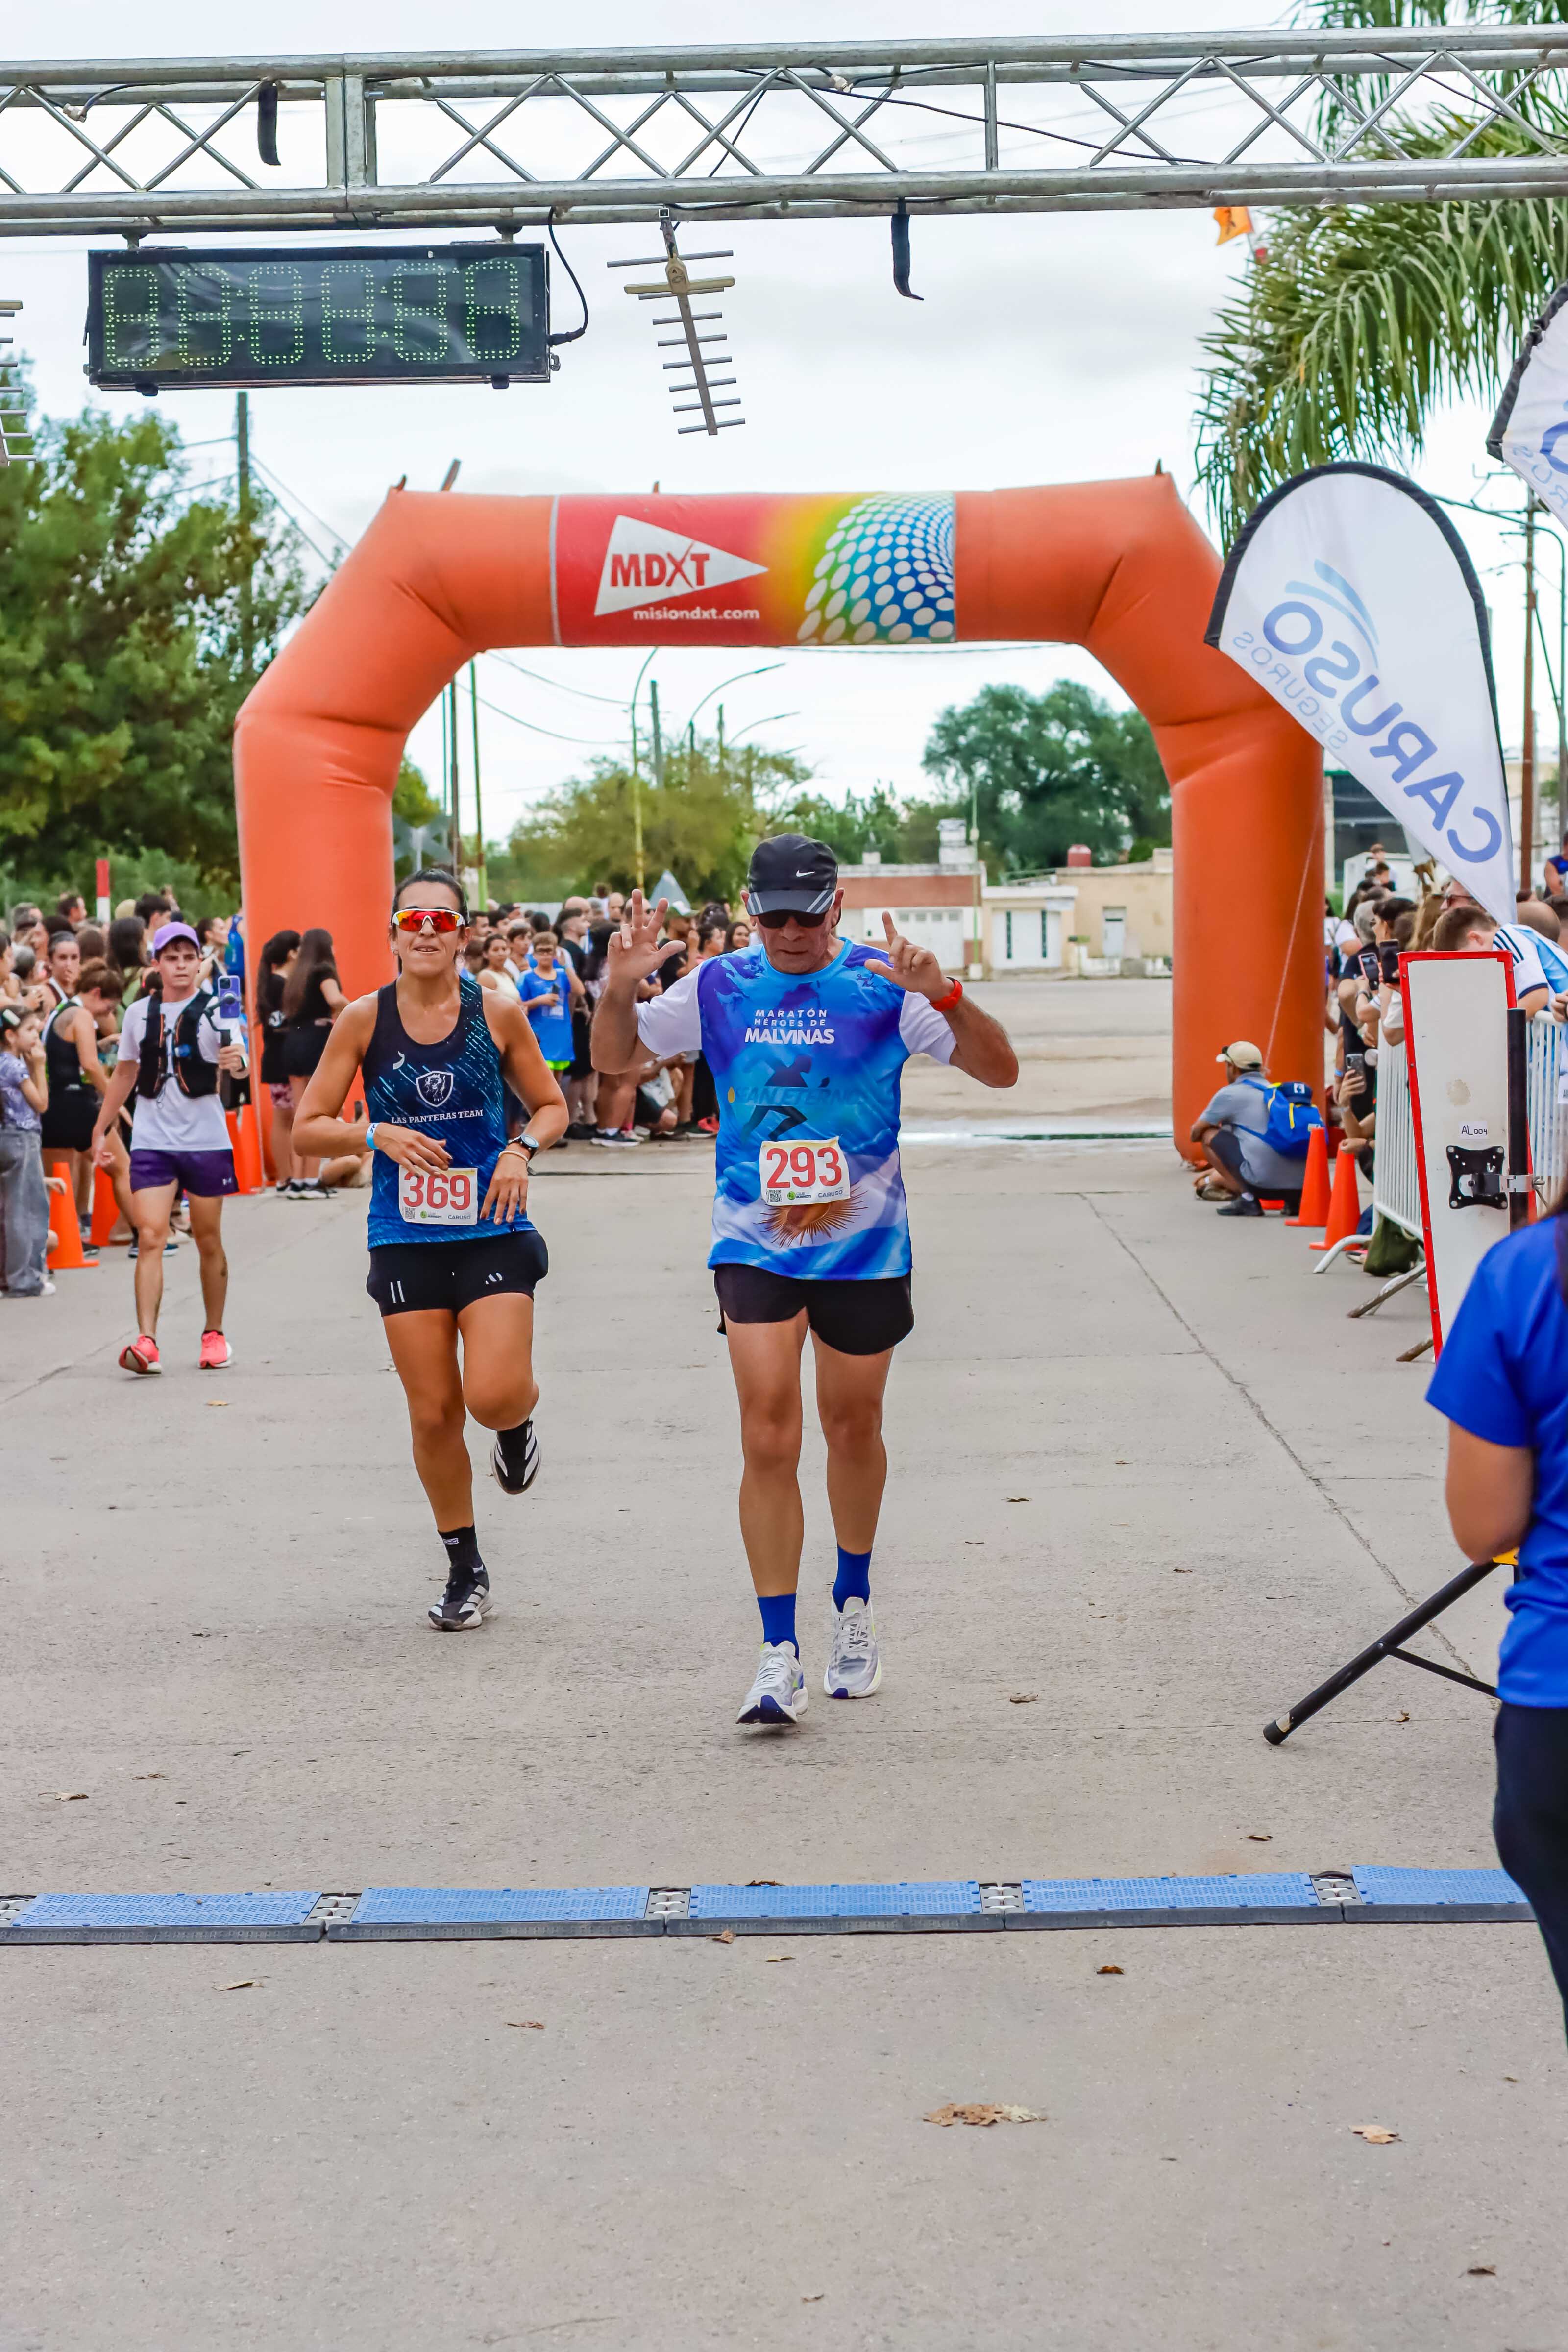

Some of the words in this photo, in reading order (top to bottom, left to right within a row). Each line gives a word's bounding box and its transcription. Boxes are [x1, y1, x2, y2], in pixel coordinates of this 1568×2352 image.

[611, 540, 710, 589] MDXT
[633, 606, 760, 621] misiondxt.com
[755, 1008, 827, 1018] MARATÓN
[754, 1018, 804, 1027] HÉROES
[744, 1027, 835, 1045] MALVINAS
[409, 1112, 457, 1123] PANTERAS
[458, 1109, 484, 1119] TEAM
[766, 1147, 842, 1188] 293
[403, 1171, 470, 1211] 369
